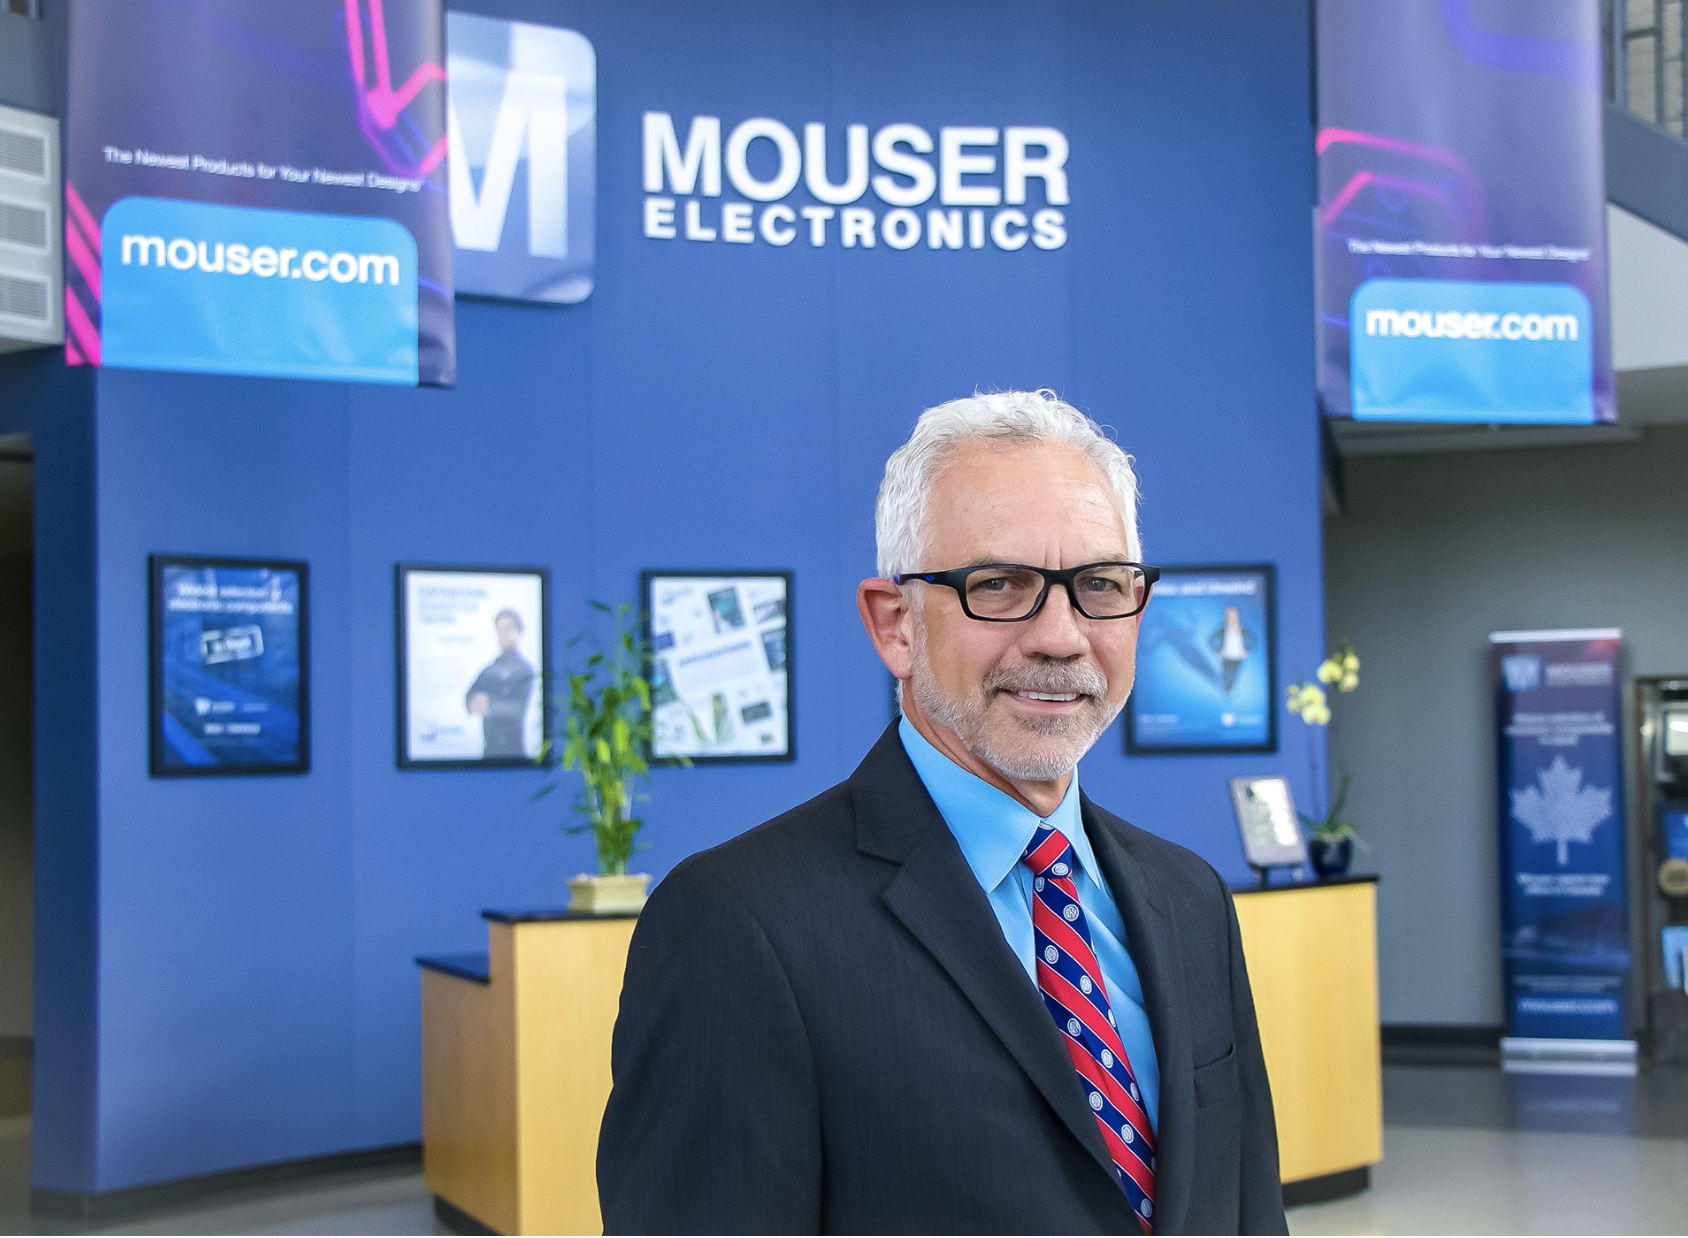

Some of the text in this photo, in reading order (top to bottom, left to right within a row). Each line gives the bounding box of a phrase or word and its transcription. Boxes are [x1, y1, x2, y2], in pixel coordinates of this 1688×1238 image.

[103, 146, 133, 165] The
[134, 149, 190, 171] Newest
[191, 154, 255, 178] Products
[257, 163, 276, 180] for
[278, 164, 311, 183] Your
[312, 167, 365, 187] Newest
[449, 71, 568, 259] M
[642, 111, 1071, 207] MOUSER
[643, 198, 1069, 252] ELECTRONICS
[121, 233, 400, 286] mouser.com
[1366, 310, 1578, 341] mouser.com
